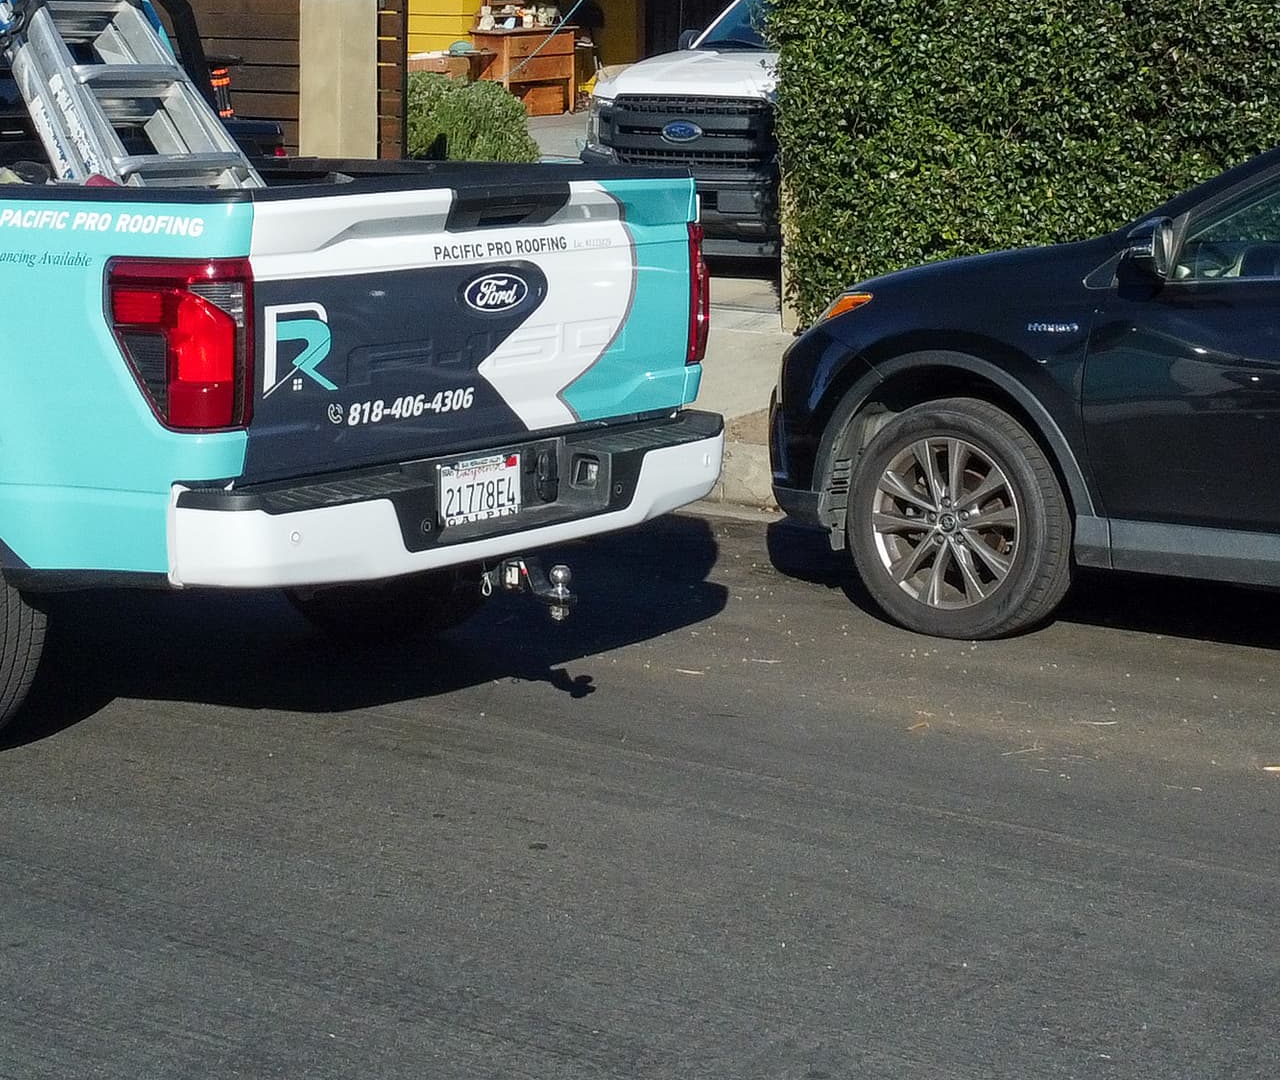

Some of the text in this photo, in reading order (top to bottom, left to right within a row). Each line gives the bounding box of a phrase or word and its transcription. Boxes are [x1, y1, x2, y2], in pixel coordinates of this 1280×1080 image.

[72, 212, 112, 232] PRO
[115, 214, 204, 237] ROOFING
[38, 250, 93, 267] Available
[433, 236, 567, 261] PACIFIC PRO ROOFING
[476, 279, 518, 306] Ford
[348, 387, 475, 426] 818-406-4306
[445, 476, 516, 518] 21778E4
